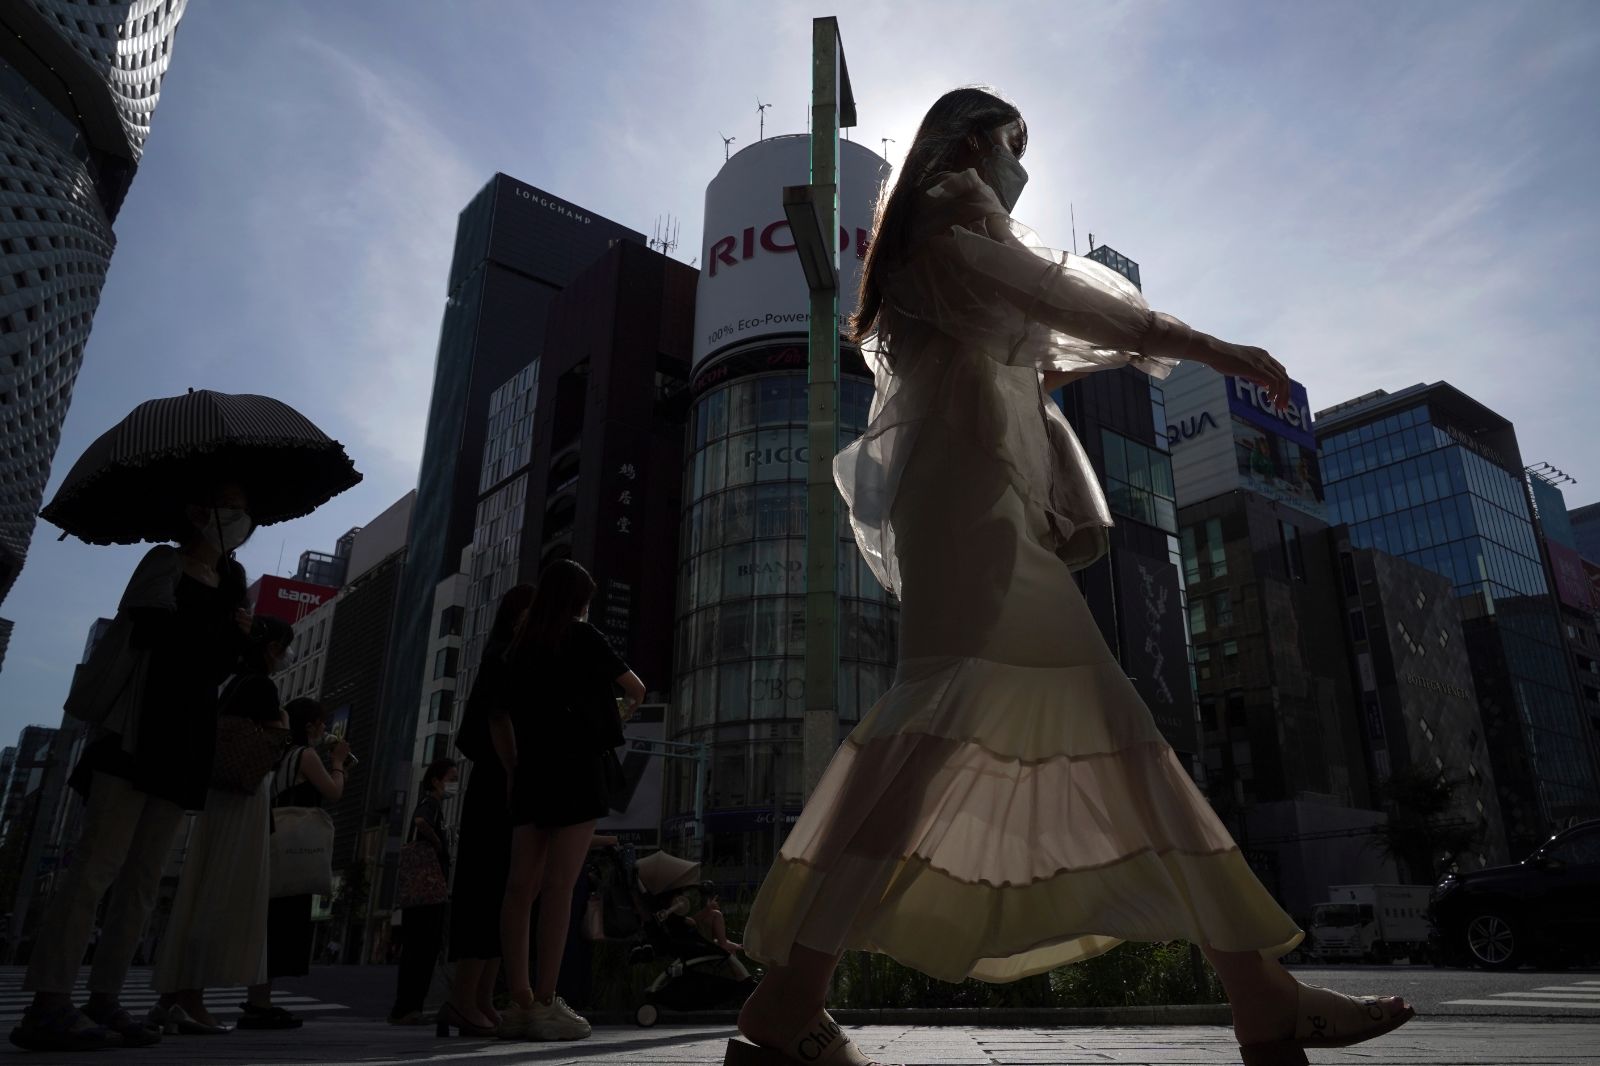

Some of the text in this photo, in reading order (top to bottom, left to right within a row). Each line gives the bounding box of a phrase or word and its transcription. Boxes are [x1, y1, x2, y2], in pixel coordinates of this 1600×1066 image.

[515, 187, 592, 225] LONGCHAMP
[708, 312, 809, 345] 100% Eco-Power
[1167, 411, 1217, 446] QUA
[738, 561, 802, 577] BRAND
[798, 1021, 841, 1062] Chlo
